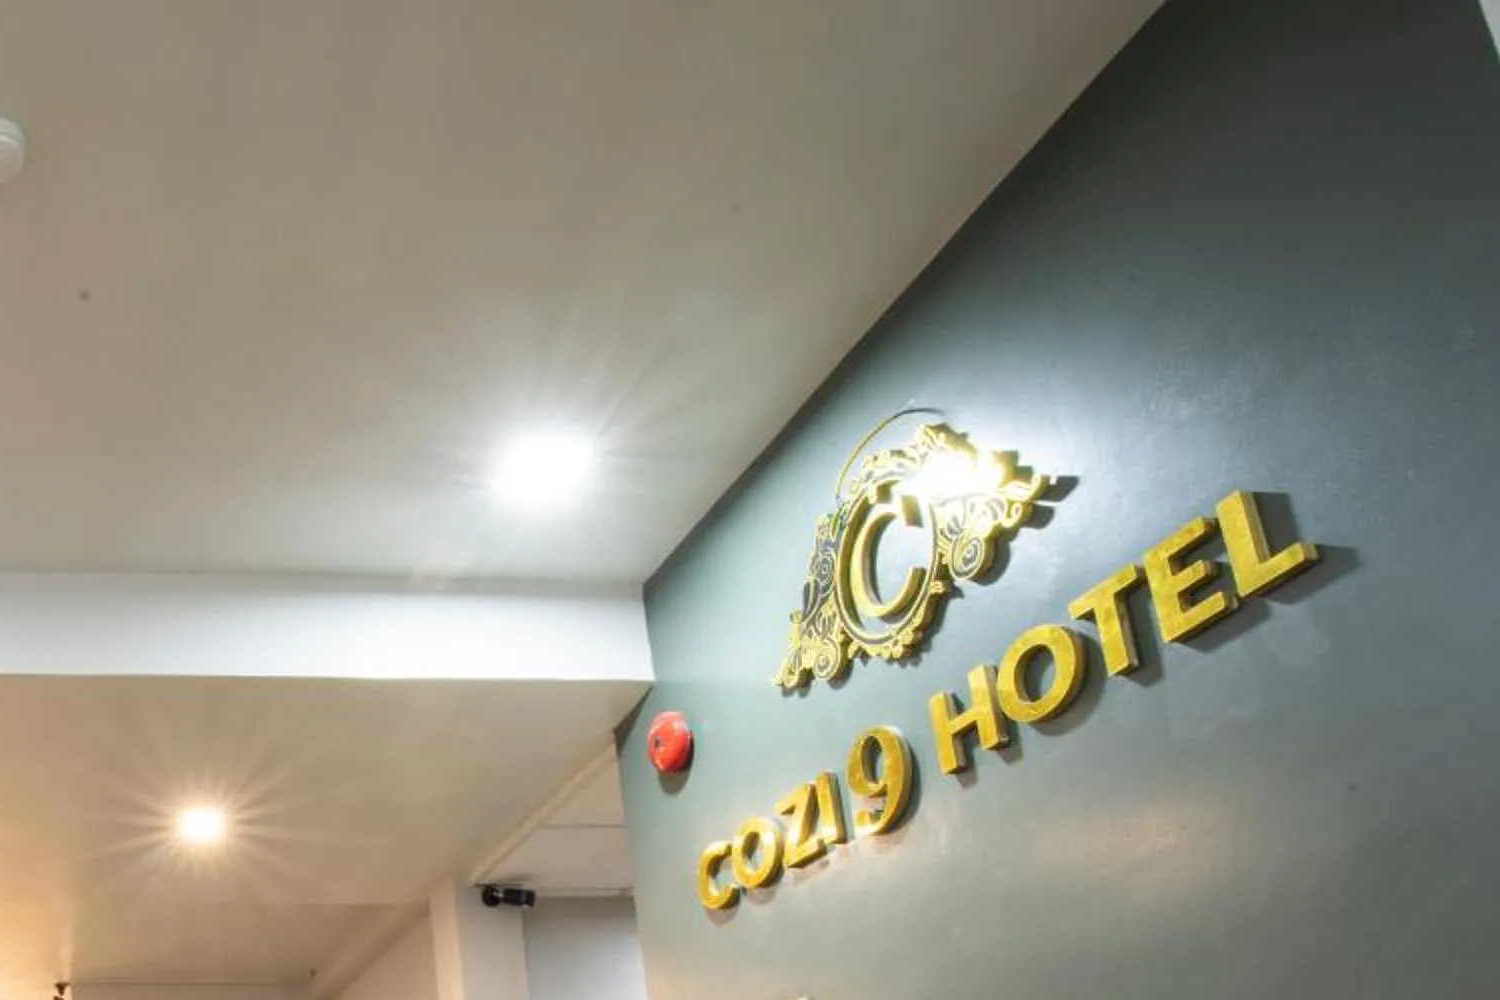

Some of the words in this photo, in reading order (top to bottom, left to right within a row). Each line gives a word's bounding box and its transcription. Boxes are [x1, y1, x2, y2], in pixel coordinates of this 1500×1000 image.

[698, 771, 844, 910] COZI
[846, 726, 913, 835] 9
[929, 490, 1316, 773] HOTEL
